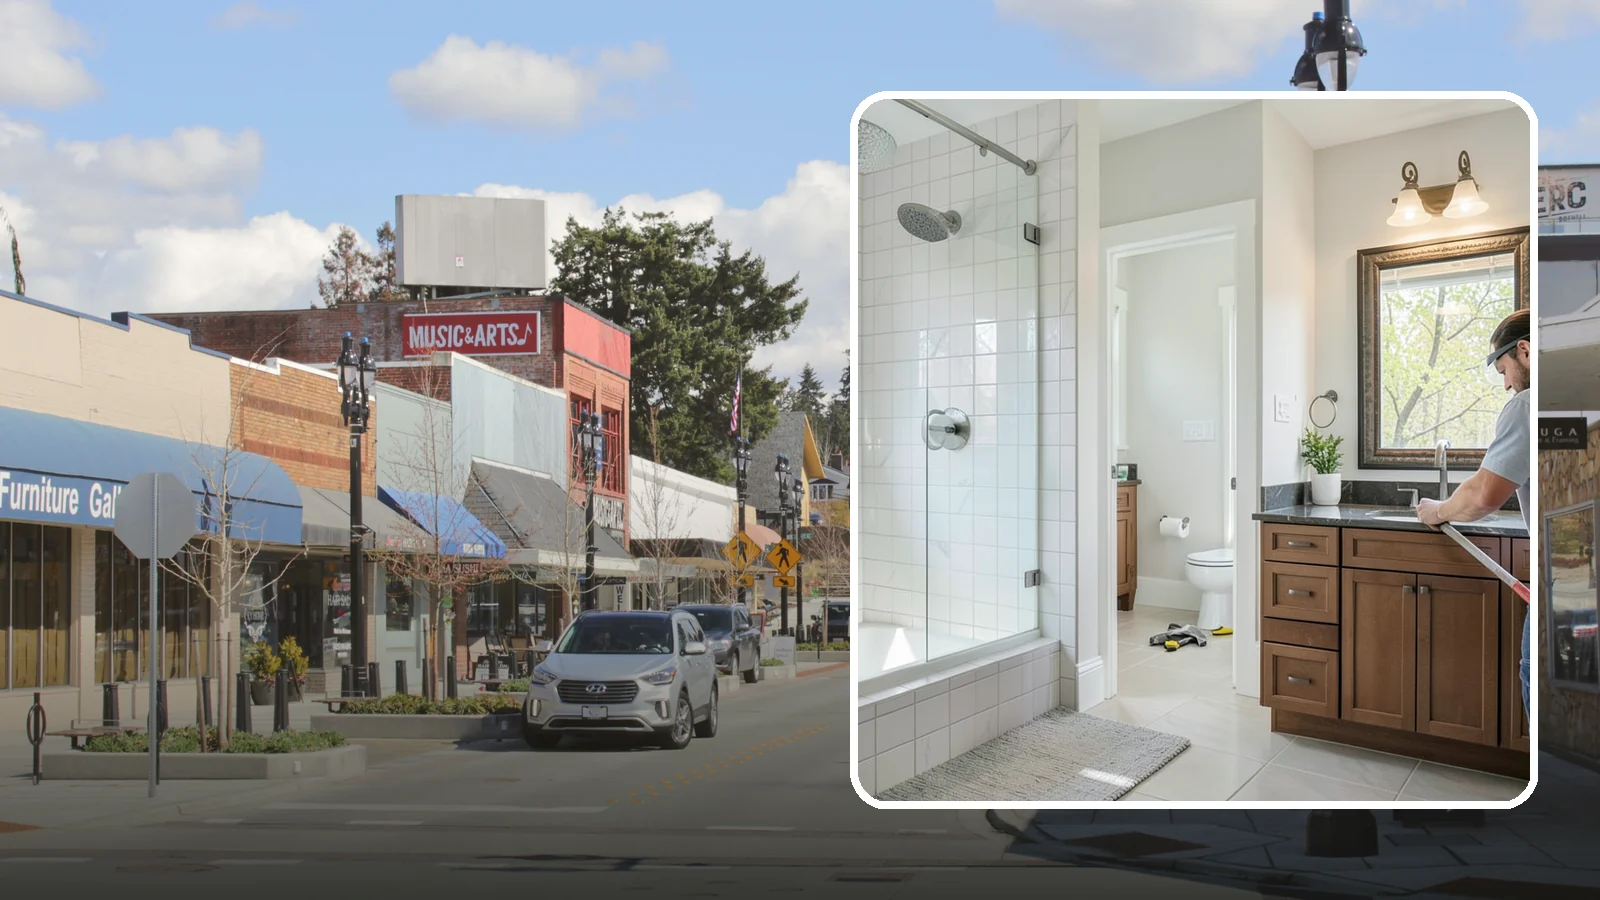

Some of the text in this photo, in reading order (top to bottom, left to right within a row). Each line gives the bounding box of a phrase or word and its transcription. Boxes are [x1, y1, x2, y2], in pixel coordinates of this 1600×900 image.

[1540, 427, 1577, 437] UGA
[0, 472, 121, 519] Furniture Gal
[453, 563, 479, 574] SUSHI
